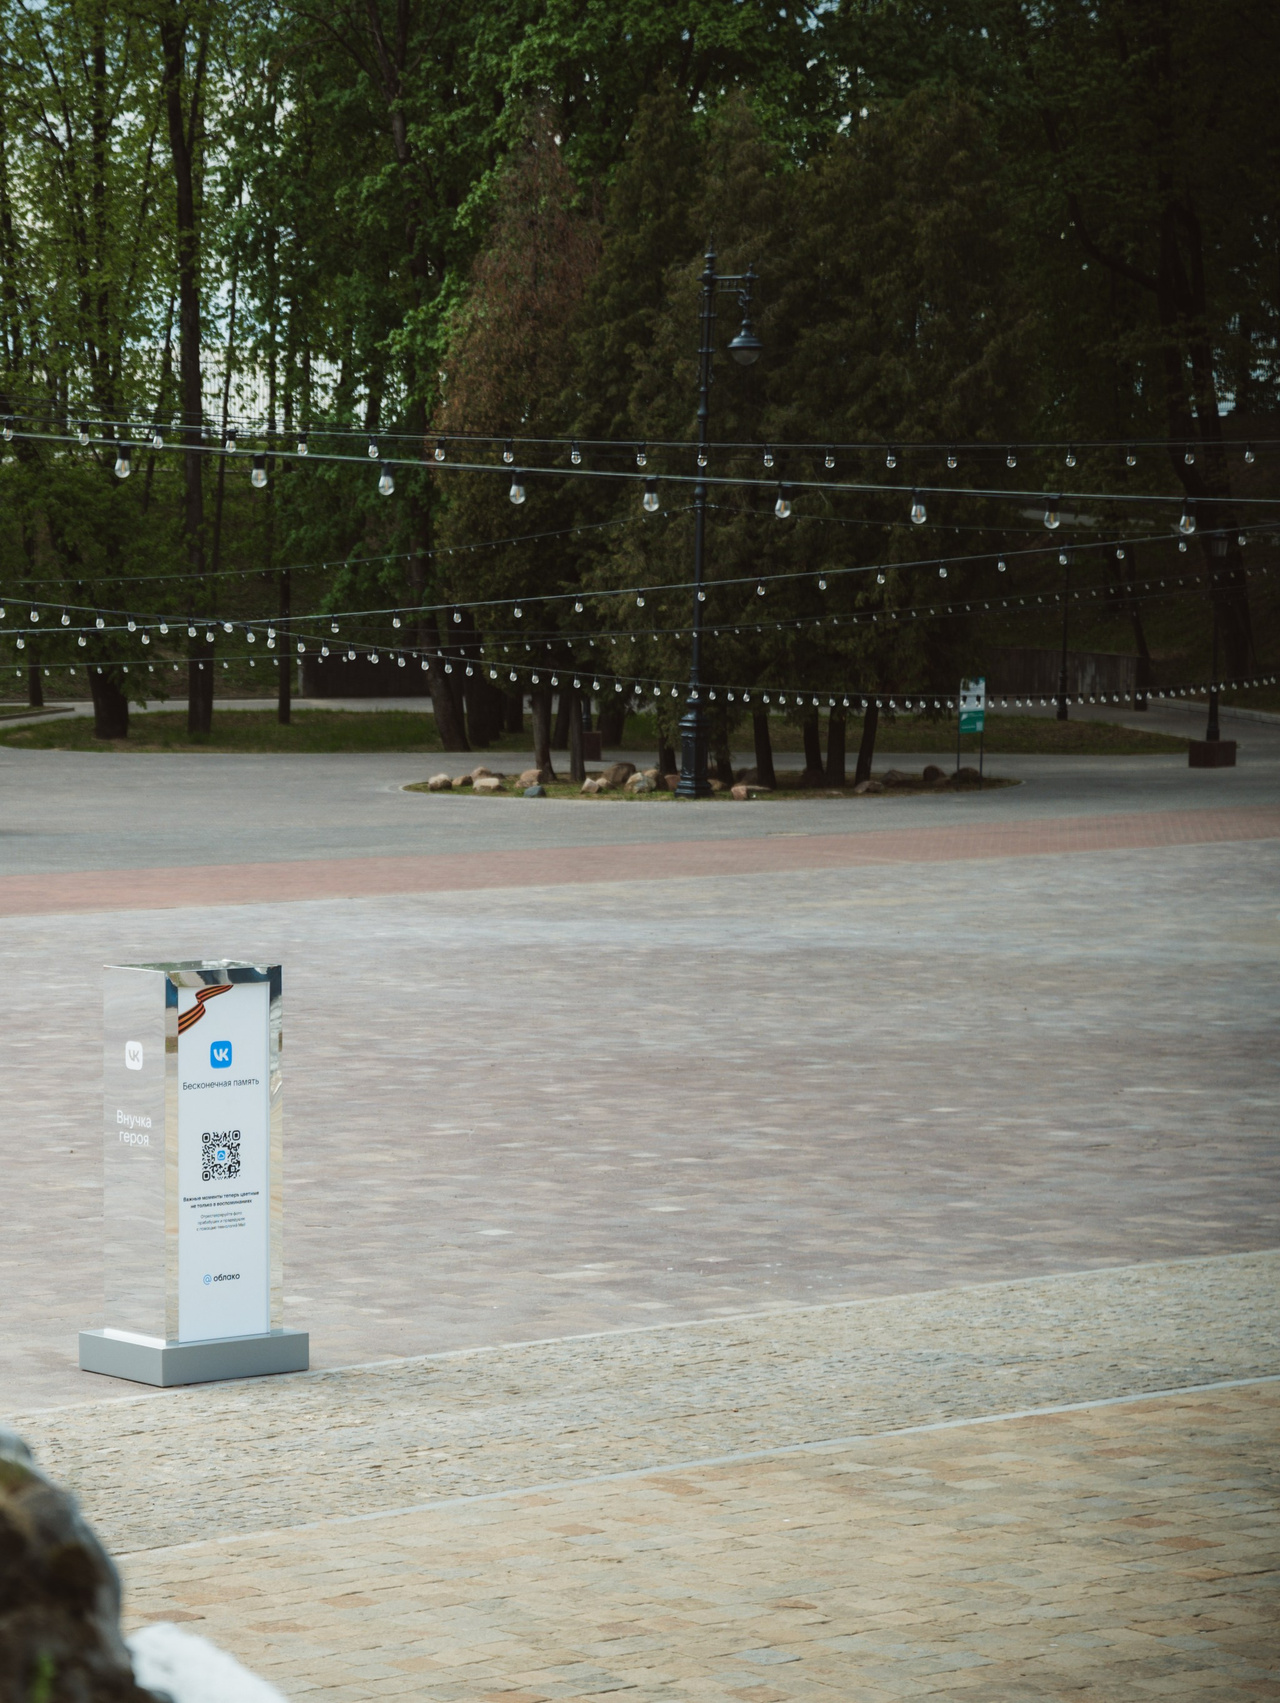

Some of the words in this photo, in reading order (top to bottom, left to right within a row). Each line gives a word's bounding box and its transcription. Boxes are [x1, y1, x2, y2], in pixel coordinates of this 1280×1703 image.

[213, 1048, 229, 1062] VK
[182, 1080, 232, 1091] Бесконечная
[233, 1077, 260, 1087] память
[116, 1109, 152, 1129] Внучка
[119, 1131, 149, 1146] героя
[213, 1273, 240, 1281] облако
